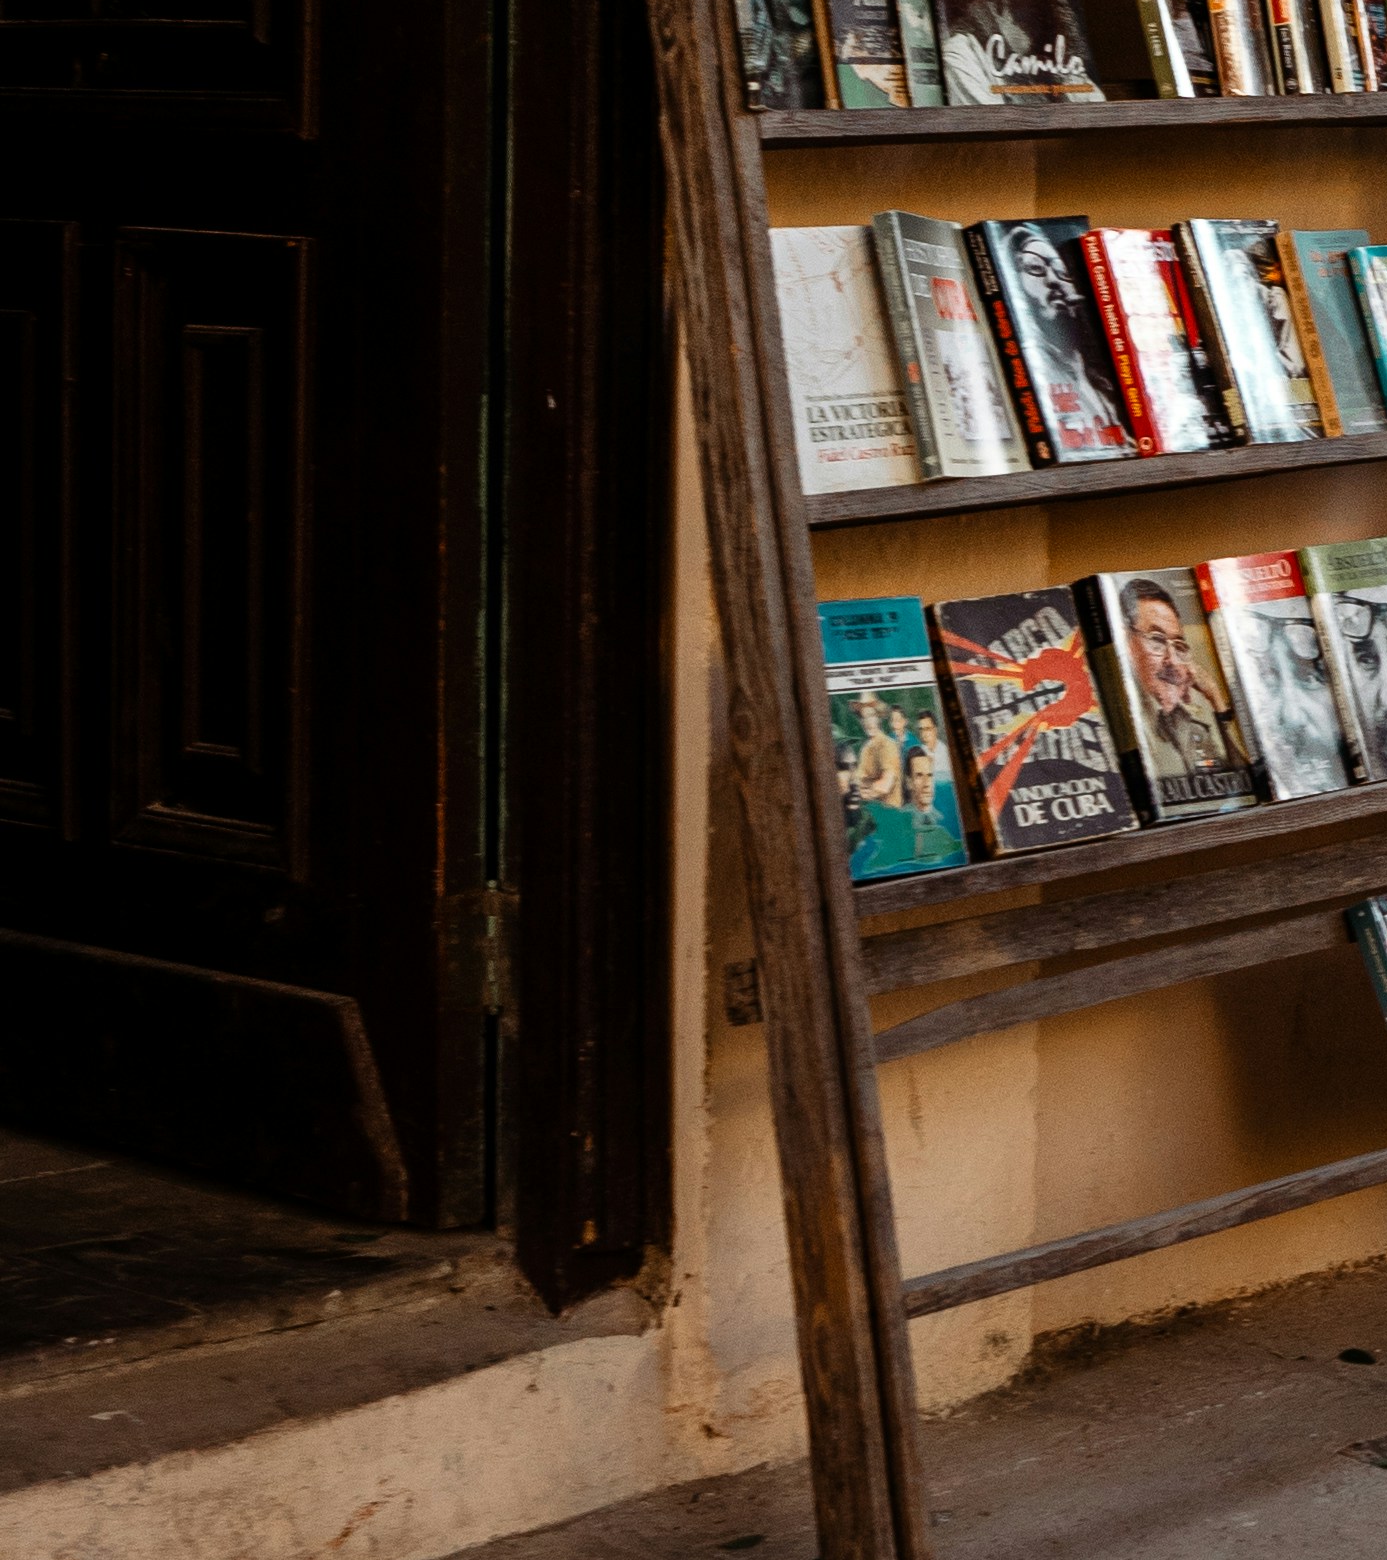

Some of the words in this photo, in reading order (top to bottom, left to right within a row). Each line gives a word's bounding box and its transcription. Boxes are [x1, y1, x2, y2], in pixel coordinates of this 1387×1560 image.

[986, 33, 1085, 77] Camilo
[1086, 235, 1102, 263] Fidel
[1094, 264, 1112, 302] Castro
[1103, 303, 1121, 336] habla
[1112, 336, 1126, 352] de
[1115, 353, 1134, 385] Playa
[829, 400, 909, 422] VICTORIA
[1014, 804, 1048, 829] DE
[1052, 797, 1115, 823] CUBA
